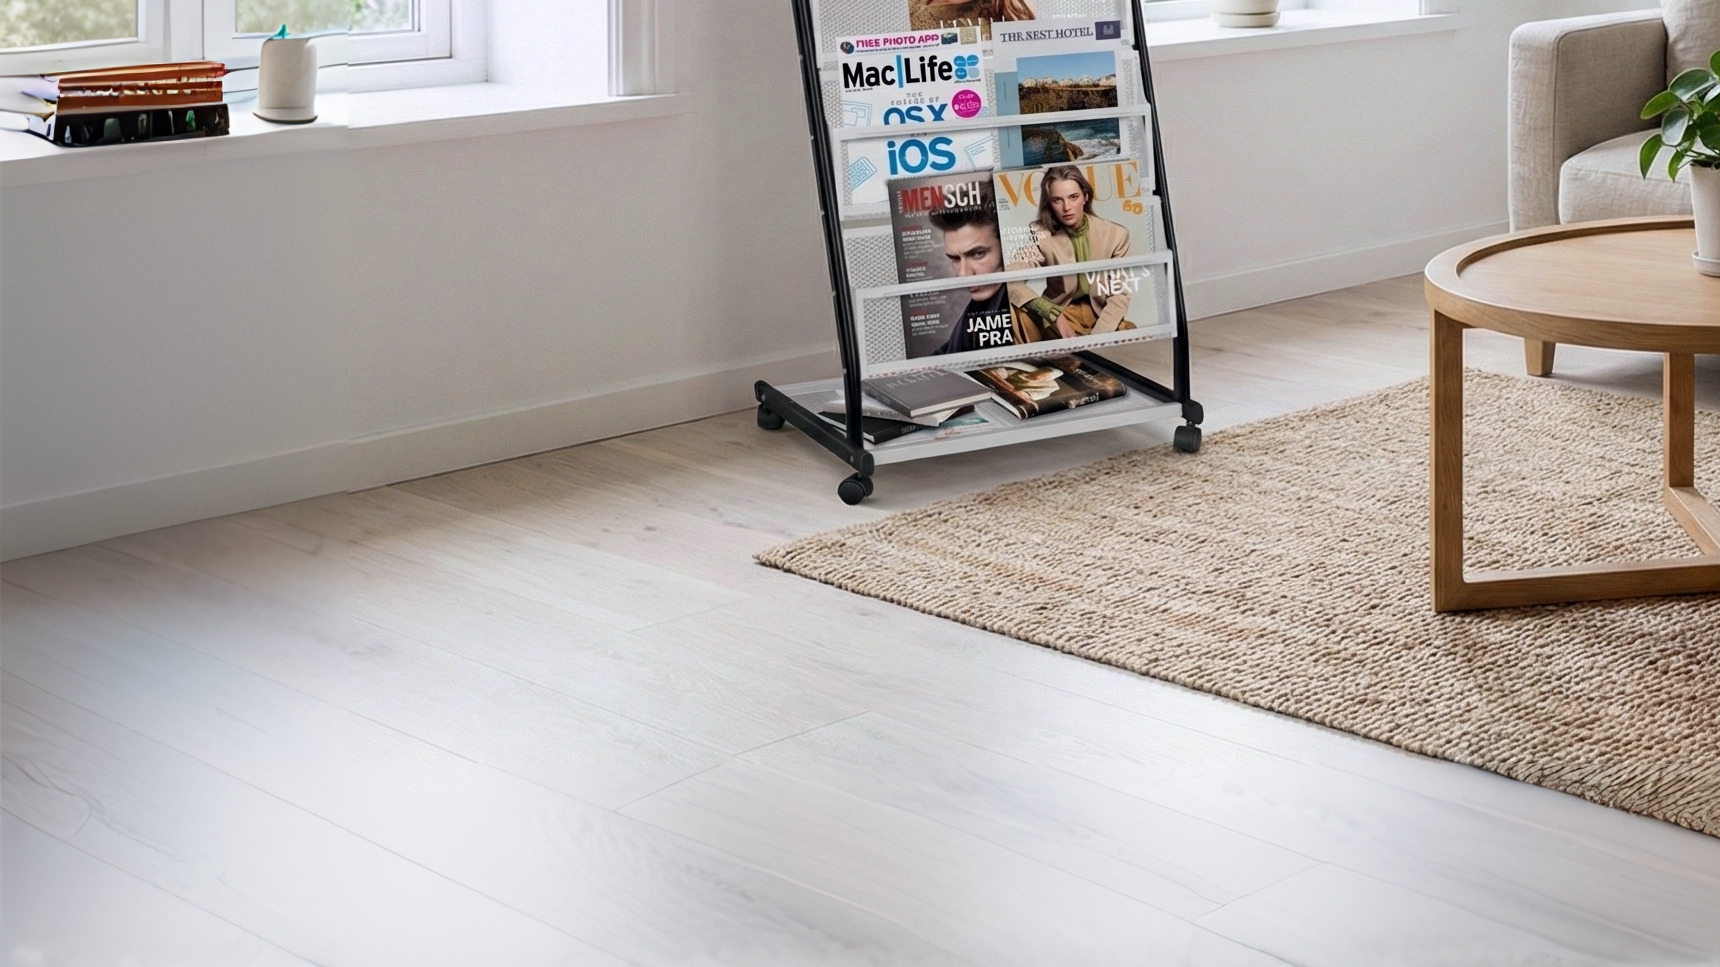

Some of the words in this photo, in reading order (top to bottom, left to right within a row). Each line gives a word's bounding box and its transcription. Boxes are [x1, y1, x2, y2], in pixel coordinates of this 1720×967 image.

[886, 136, 957, 176] iOS
[901, 181, 981, 213] MENSCH
[998, 160, 1142, 208] VOUE
[1097, 277, 1141, 297] NEXT
[978, 329, 1014, 347] PRA
